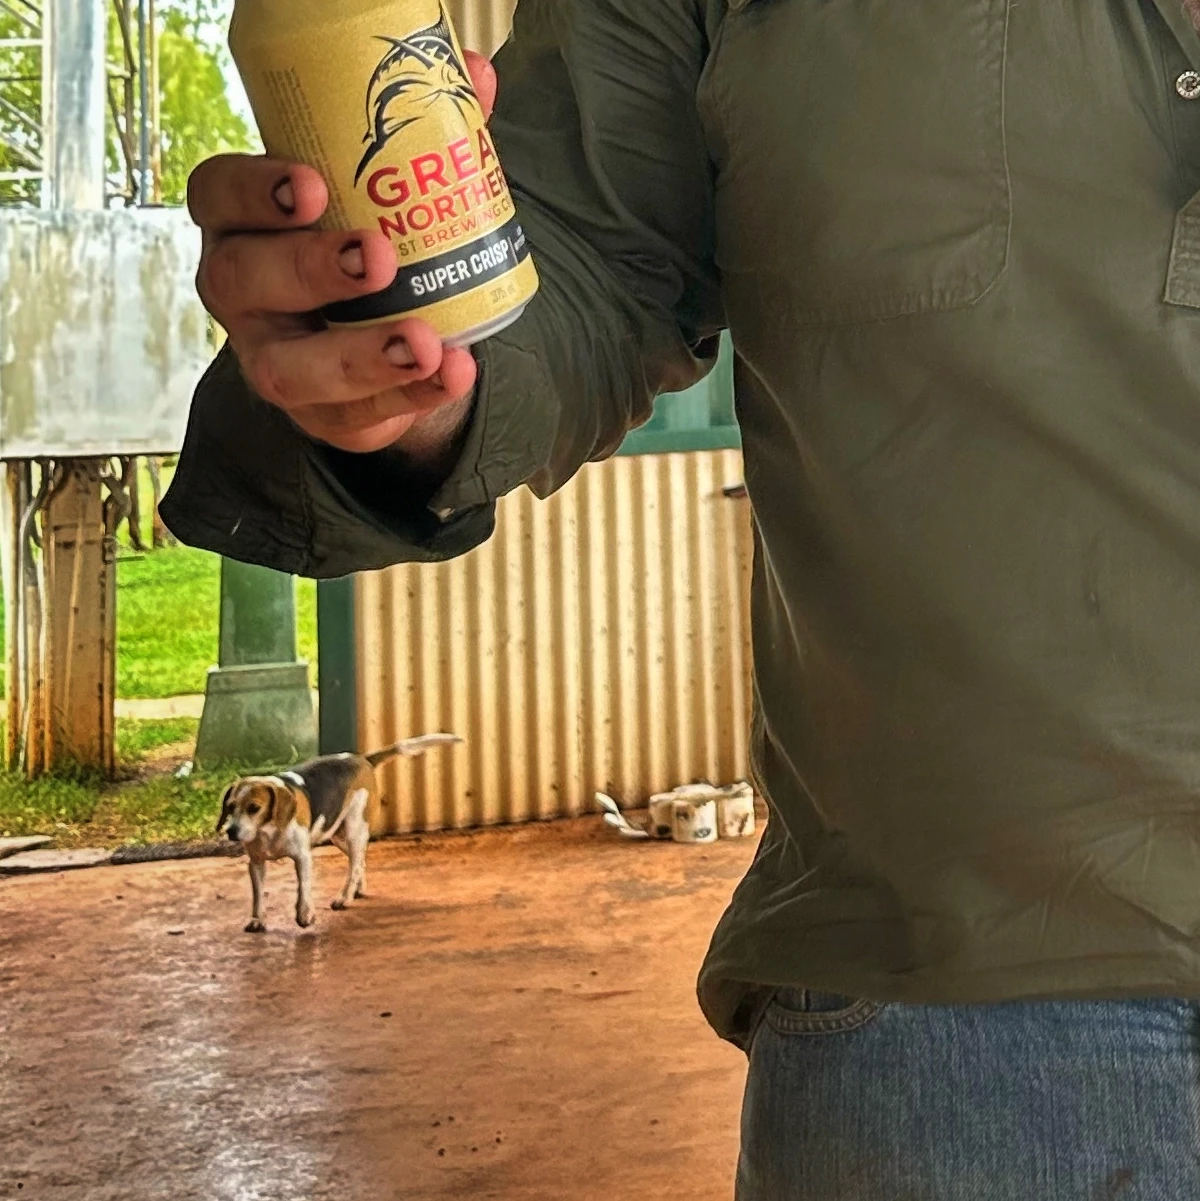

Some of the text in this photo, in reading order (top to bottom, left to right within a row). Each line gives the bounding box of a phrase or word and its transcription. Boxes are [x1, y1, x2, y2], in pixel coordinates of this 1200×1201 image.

[366, 126, 497, 208] GREA
[421, 204, 501, 249] BREWING
[410, 262, 471, 296] SUPER
[469, 238, 509, 275] CRISP
